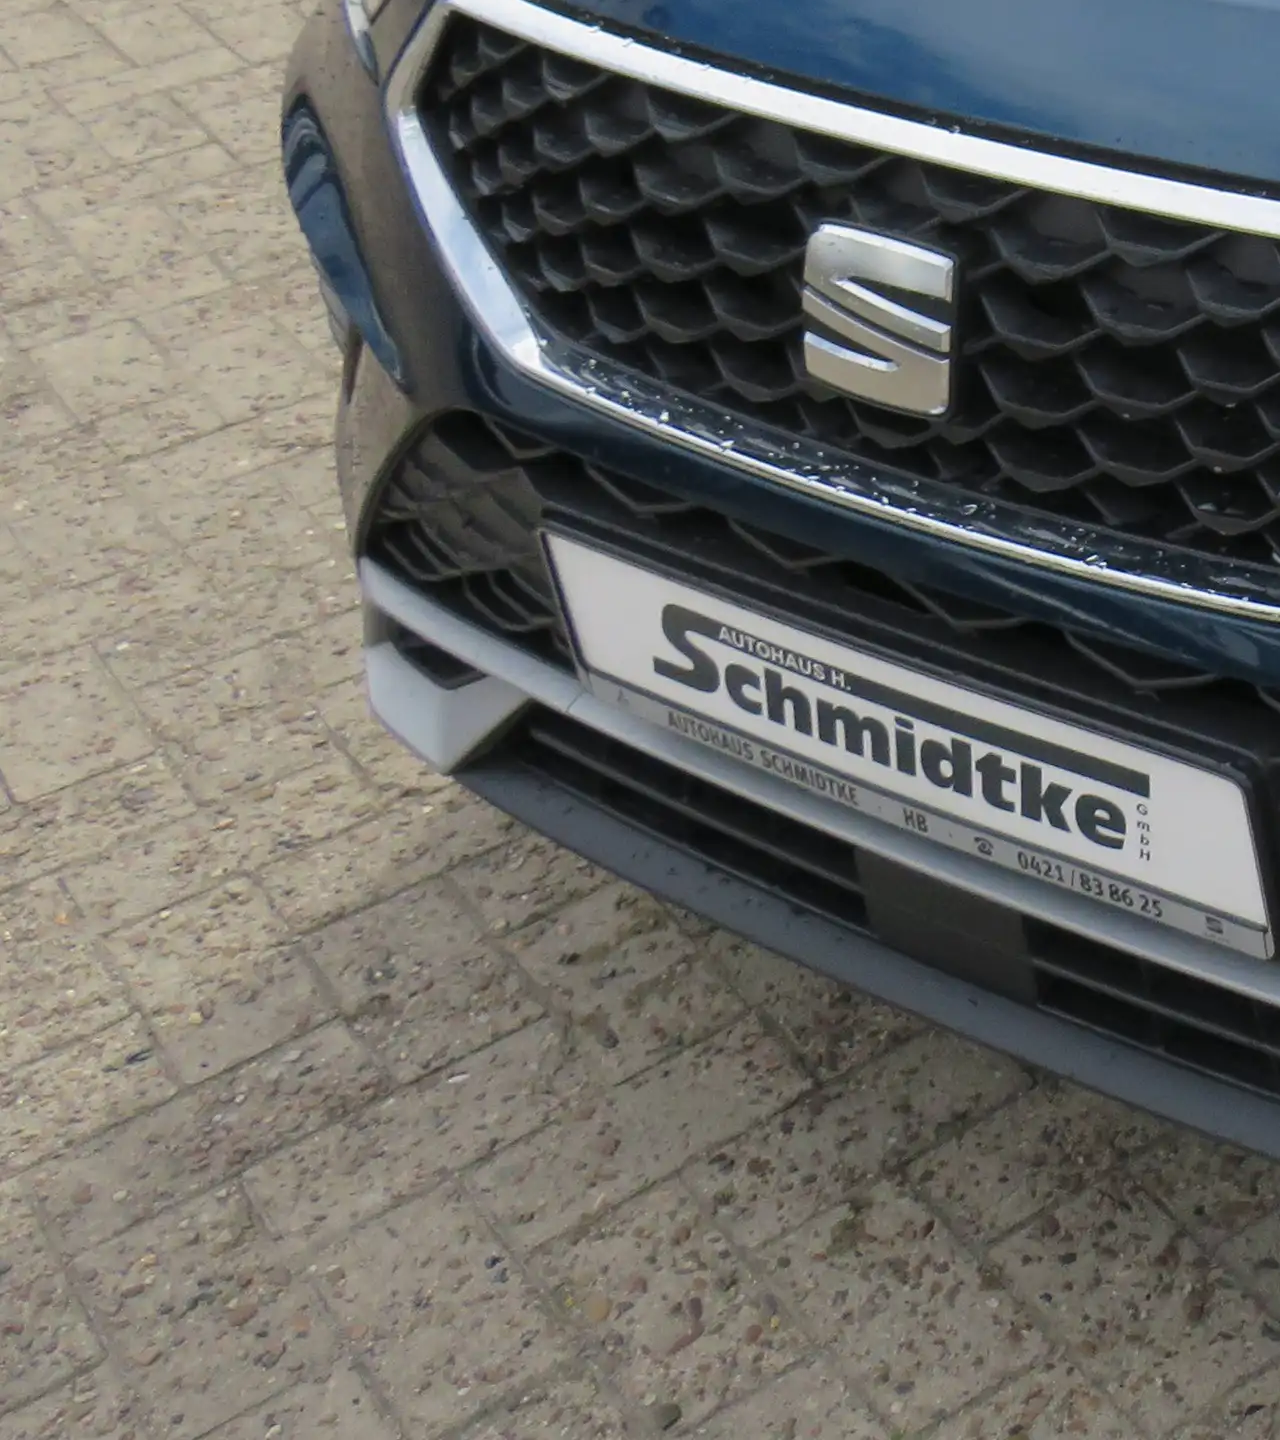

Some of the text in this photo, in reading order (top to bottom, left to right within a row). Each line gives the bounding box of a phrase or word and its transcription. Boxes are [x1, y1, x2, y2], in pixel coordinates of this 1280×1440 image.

[718, 626, 852, 691] AUTOHAUS H.
[652, 603, 1138, 851] Schmidtke
[667, 710, 755, 762] AUTOHAUS
[760, 749, 860, 807] SCHMIDTKE
[903, 807, 929, 833] HB
[1139, 893, 1163, 918] 25
[1136, 802, 1151, 862] GmbH
